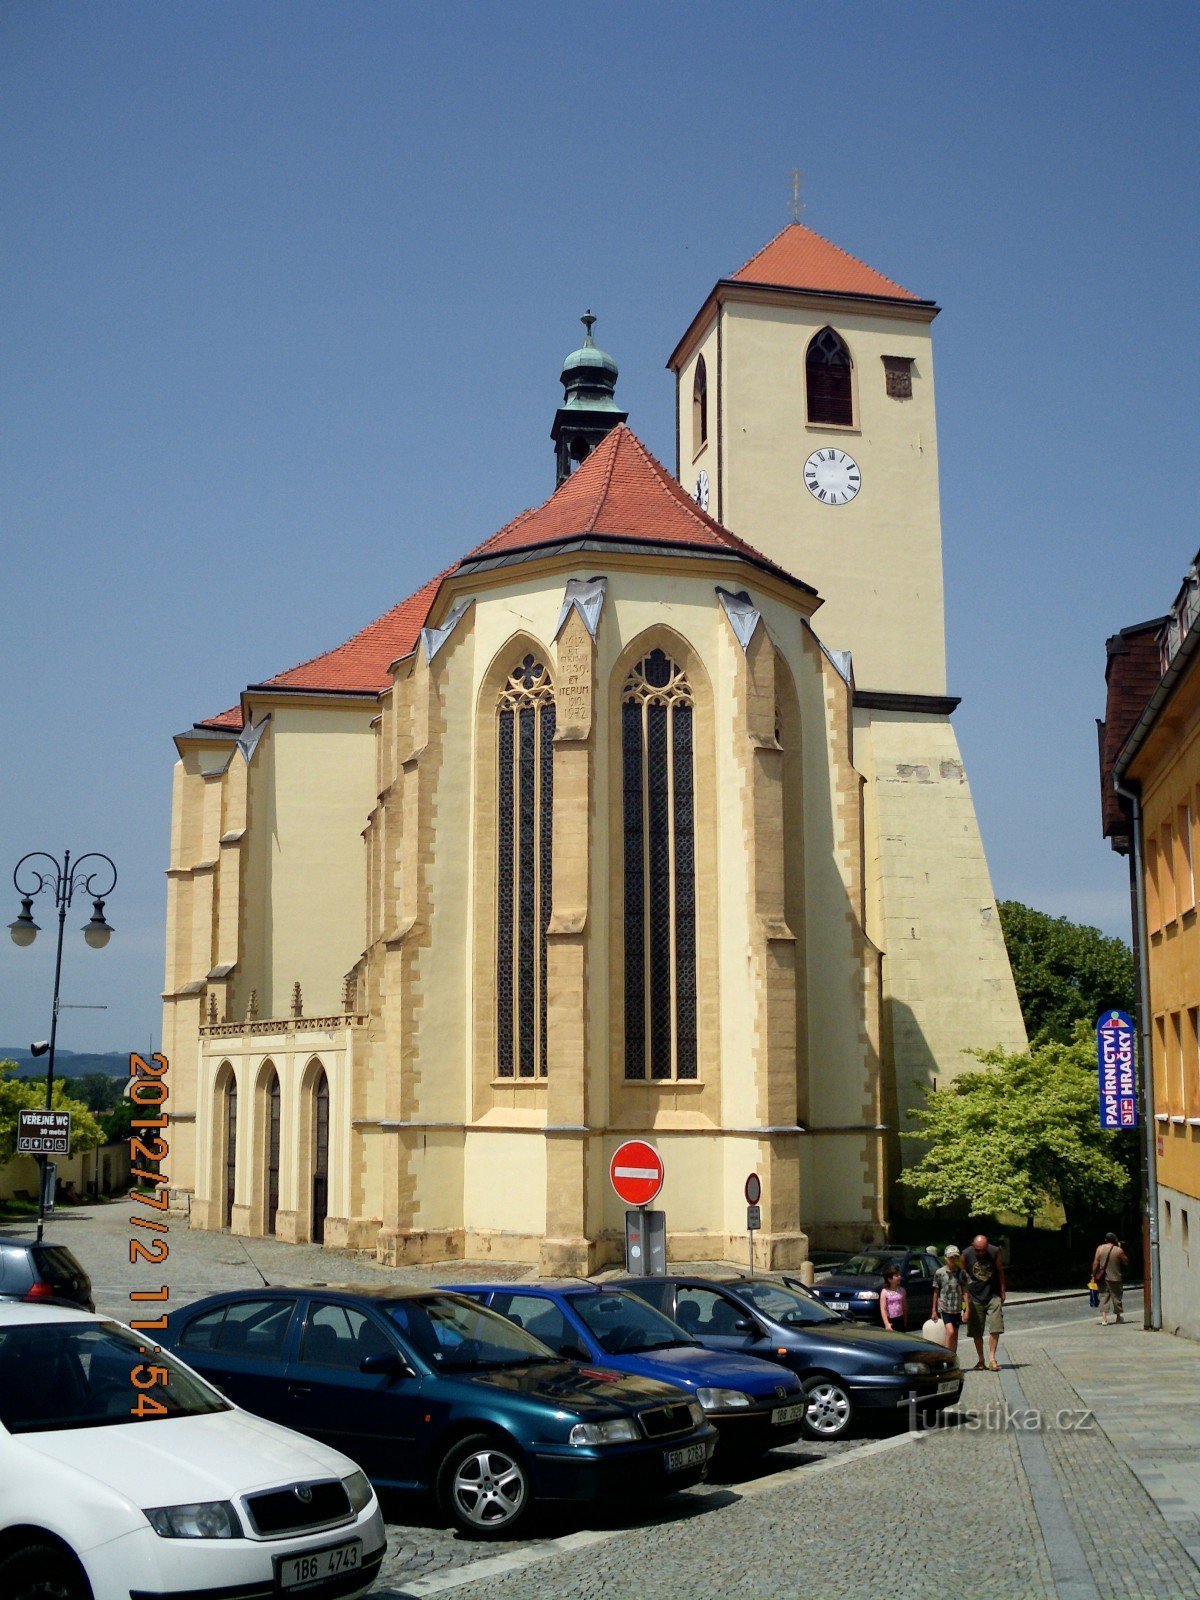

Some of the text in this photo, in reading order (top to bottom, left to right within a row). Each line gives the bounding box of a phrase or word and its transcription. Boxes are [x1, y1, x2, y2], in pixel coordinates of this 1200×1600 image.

[559, 686, 589, 696] ITERUM
[568, 675, 579, 685] ET
[1116, 1030, 1132, 1095] HRAČKY
[1100, 1029, 1118, 1125] PAPÍRNICTVÍ
[22, 1113, 68, 1126] VEŘEJNÉ WC
[293, 1546, 358, 1581] 1B6 4743
